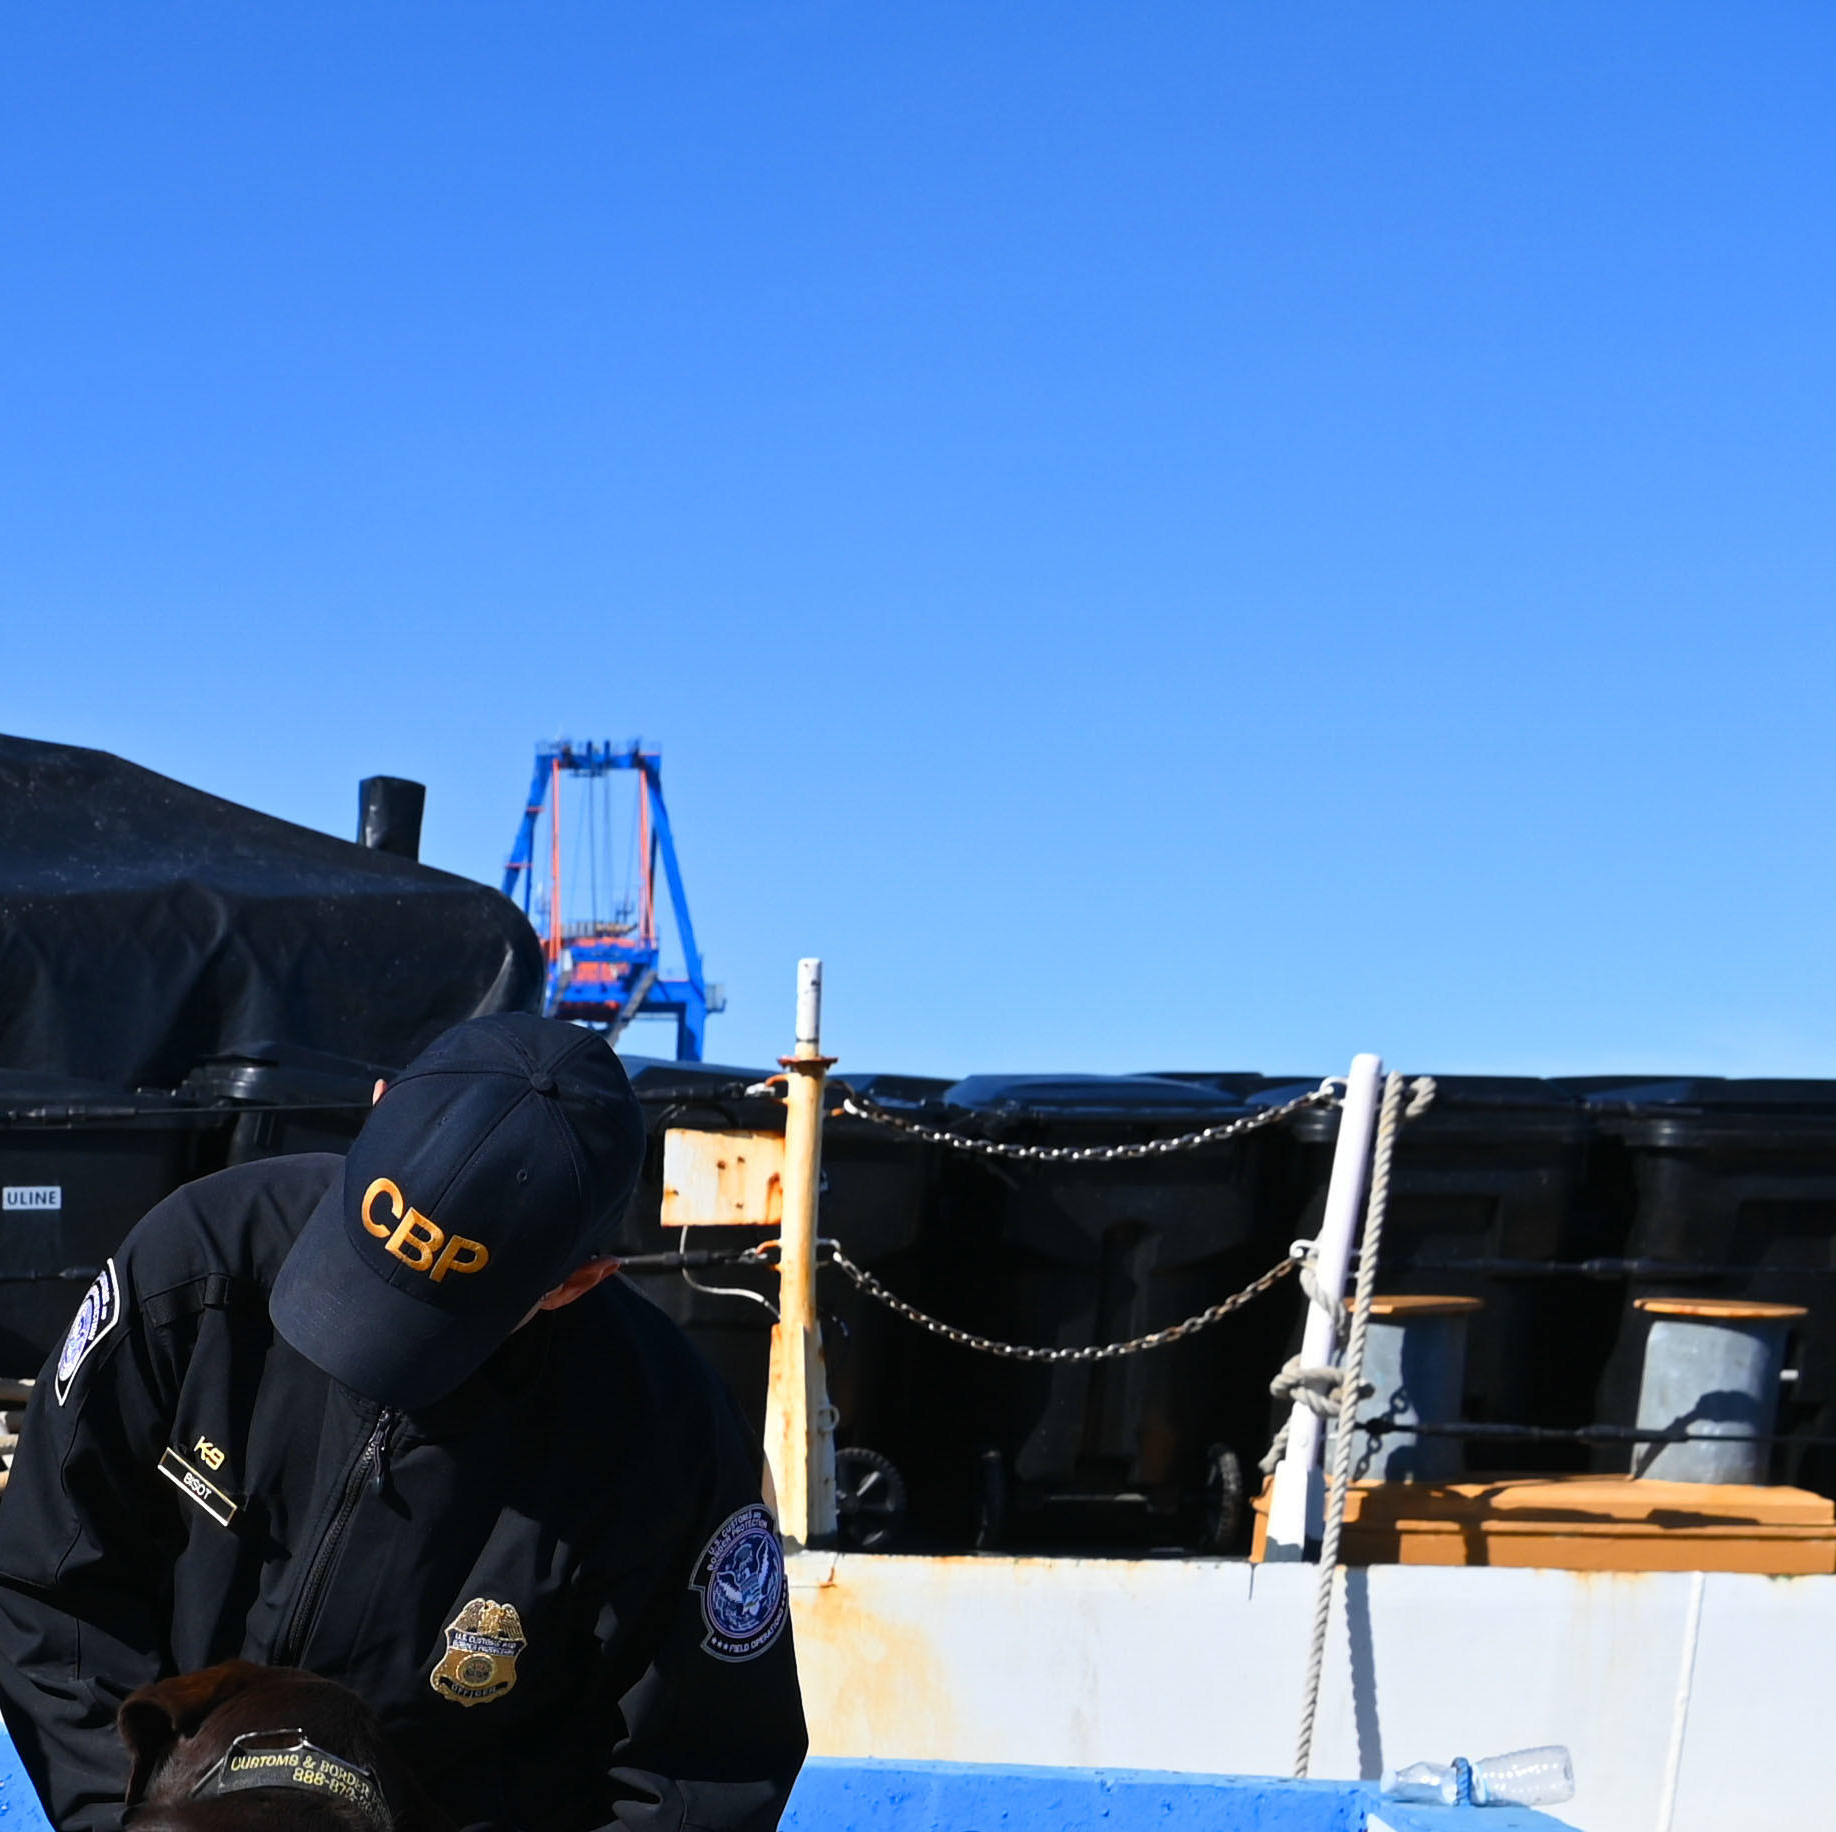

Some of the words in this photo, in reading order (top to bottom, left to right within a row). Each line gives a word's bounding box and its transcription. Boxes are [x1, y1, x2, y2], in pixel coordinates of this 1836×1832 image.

[7, 1190, 57, 1206] ULINE
[361, 1177, 489, 1283] CBP
[183, 1472, 212, 1500] BISOT
[721, 1510, 753, 1538] CUSTOMS
[729, 1643, 750, 1654] FIELD
[451, 1684, 498, 1699] OFFICER
[231, 1754, 299, 1772] CUSTOMS
[302, 1755, 316, 1770] &
[319, 1760, 370, 1799] BORDER
